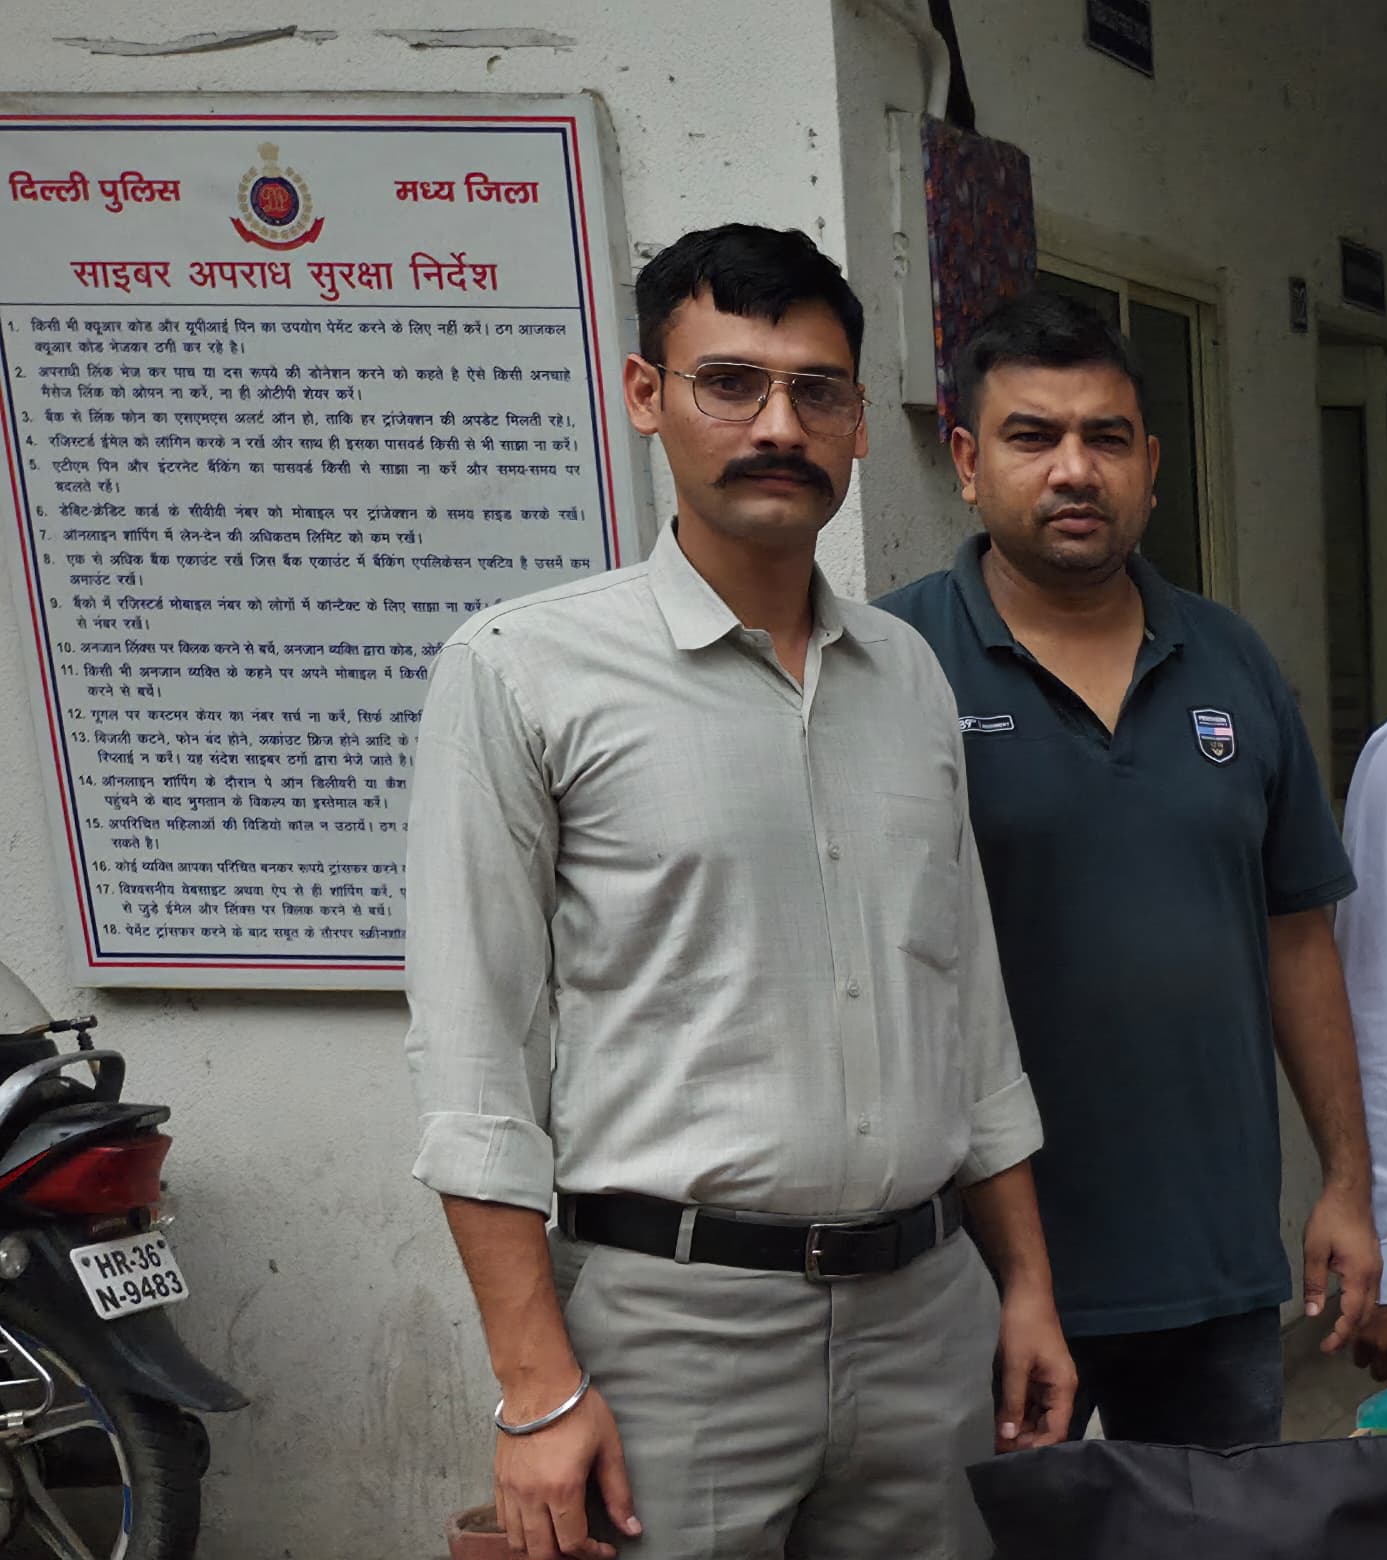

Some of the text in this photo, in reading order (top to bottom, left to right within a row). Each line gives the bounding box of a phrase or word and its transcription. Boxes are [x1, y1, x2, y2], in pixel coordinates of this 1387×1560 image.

[10, 170, 180, 213] दिल्ली पुलिस
[396, 172, 538, 204] मध्य जिला
[71, 252, 498, 301] साइबर अपराध सुरक्षा निर्देश
[94, 1244, 161, 1279] HR-36
[96, 1271, 182, 1312] N-9483
